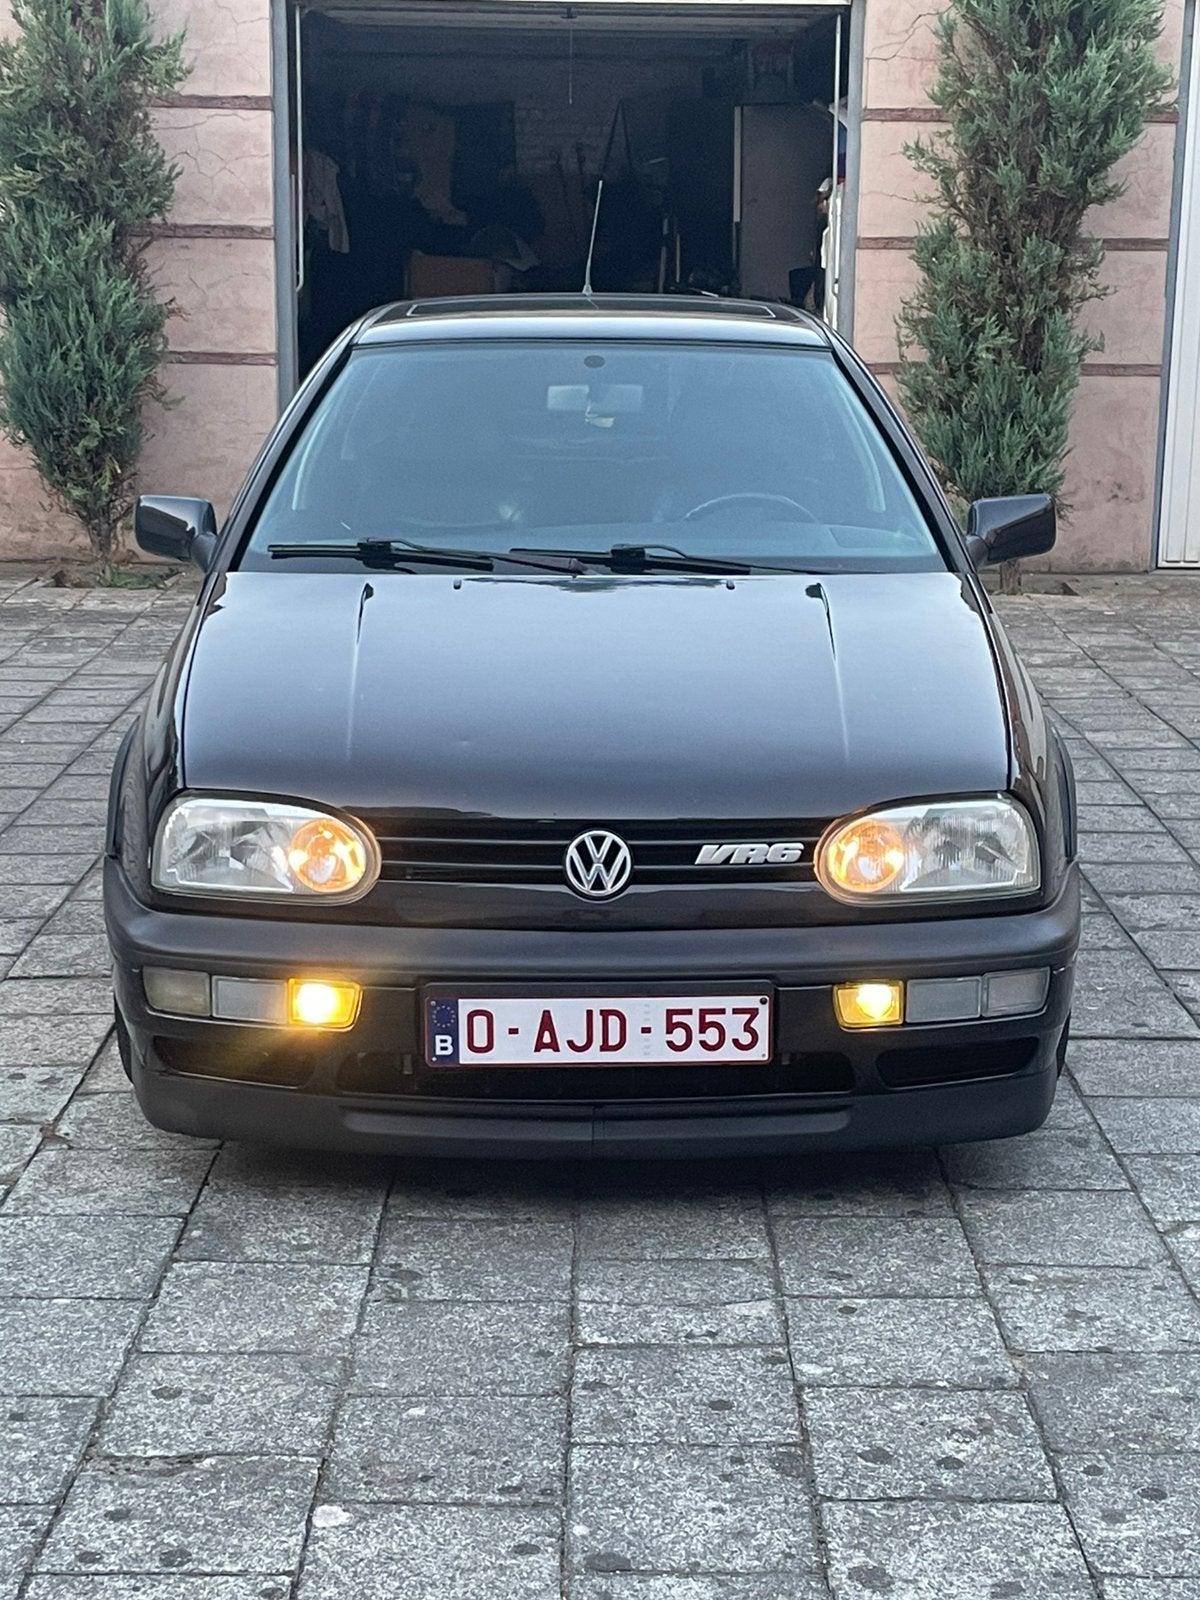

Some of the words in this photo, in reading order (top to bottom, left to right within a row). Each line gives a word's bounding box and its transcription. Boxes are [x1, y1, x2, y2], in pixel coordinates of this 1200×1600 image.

[566, 831, 631, 896] VW
[694, 842, 805, 865] VR6
[434, 1034, 454, 1056] B
